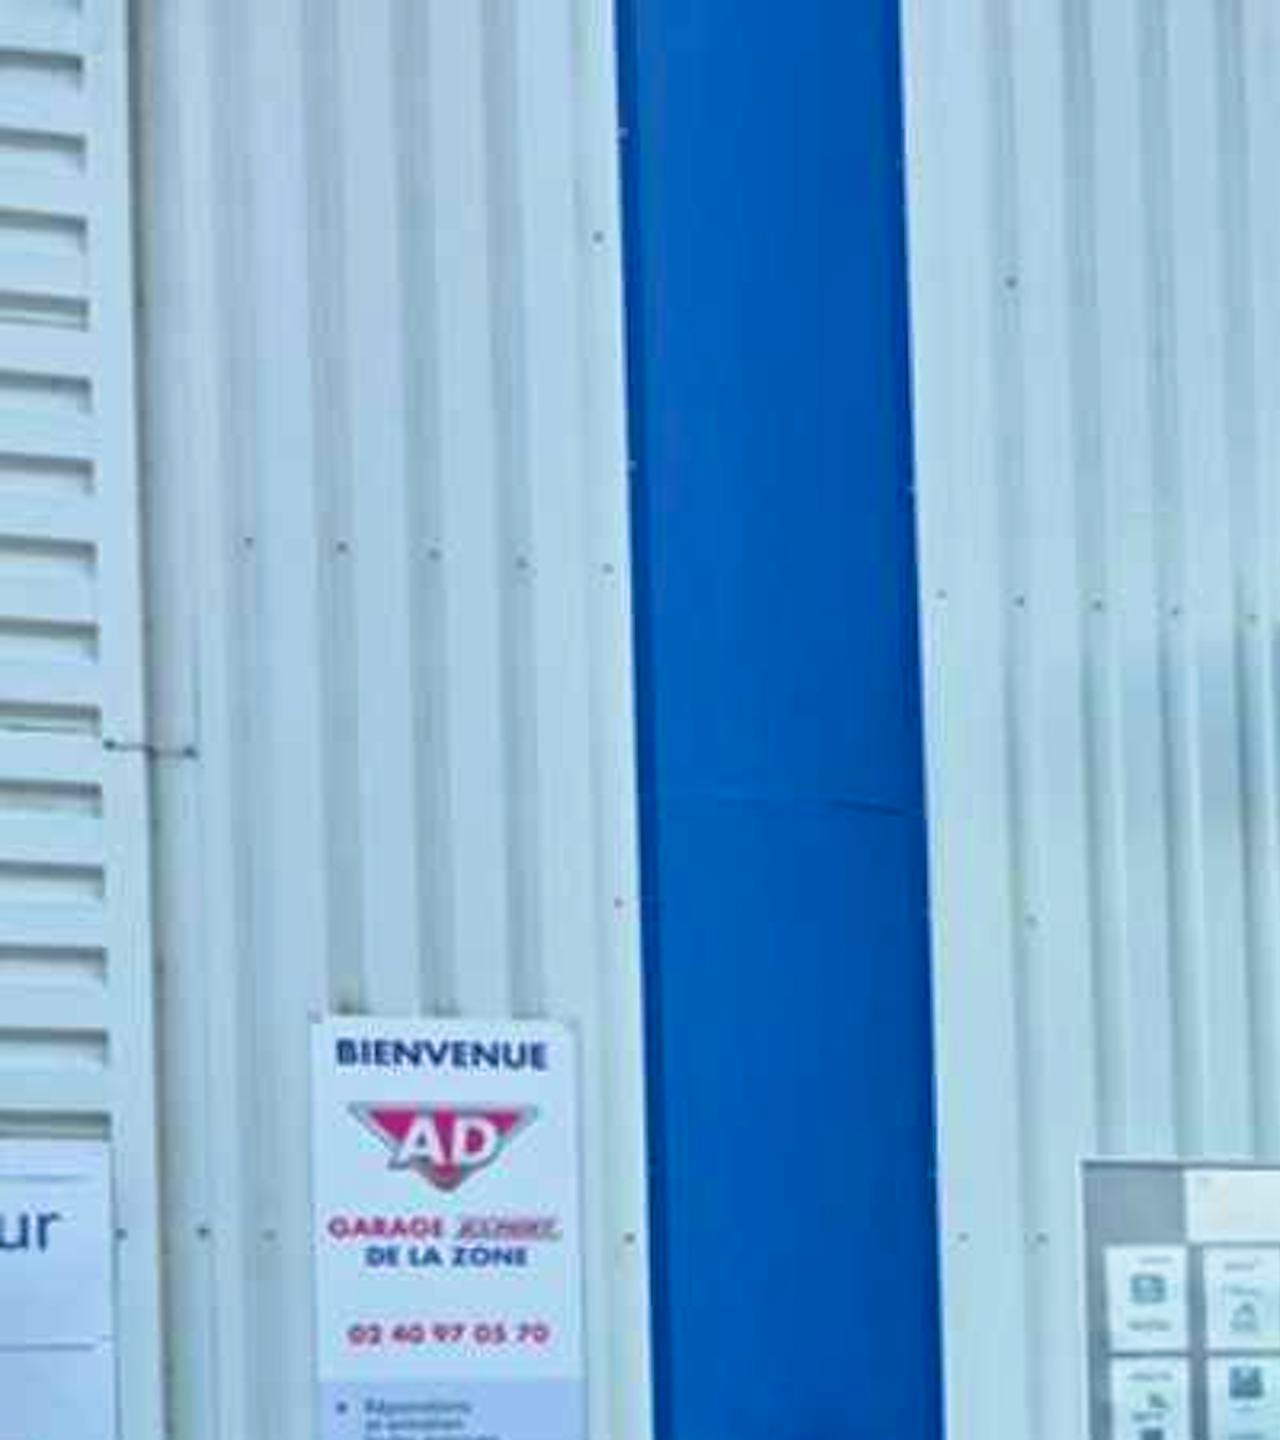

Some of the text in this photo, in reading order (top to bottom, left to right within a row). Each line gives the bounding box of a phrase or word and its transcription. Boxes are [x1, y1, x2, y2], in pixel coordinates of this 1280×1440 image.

[336, 1039, 548, 1071] BIENVENUE
[397, 1115, 499, 1164] AD
[328, 1216, 443, 1240] GARAGE
[365, 1246, 528, 1267] DE LA ZONE
[348, 1323, 382, 1345] 02
